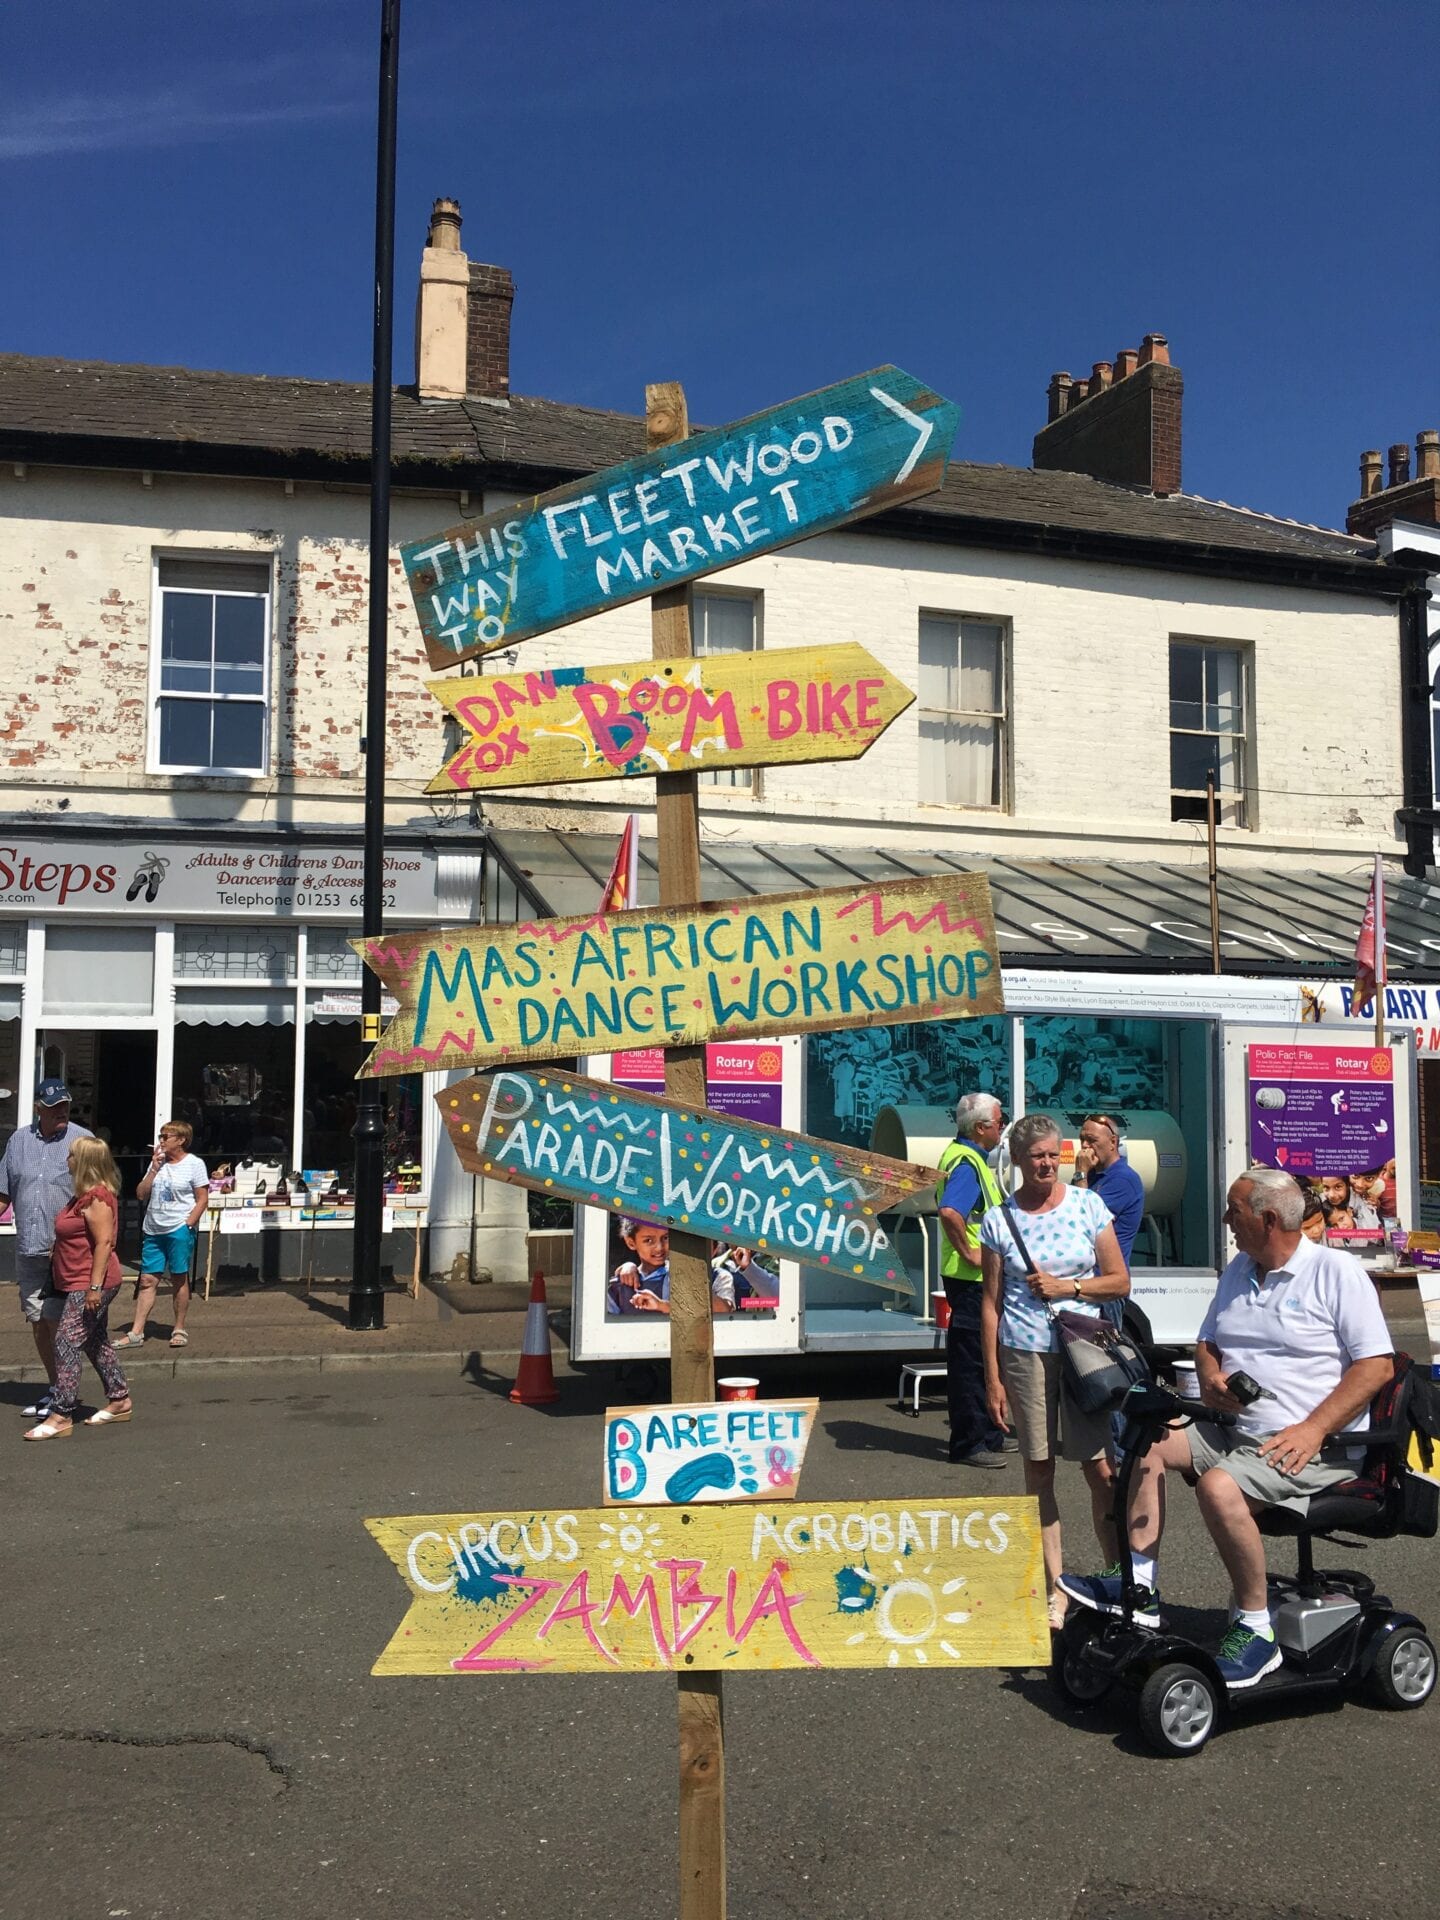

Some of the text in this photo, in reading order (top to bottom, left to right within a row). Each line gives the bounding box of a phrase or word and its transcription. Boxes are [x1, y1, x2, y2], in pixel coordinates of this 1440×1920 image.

[543, 416, 853, 559] FLEETWOOD
[413, 520, 527, 582] THIS
[596, 480, 799, 594] MARKET
[431, 564, 519, 626] WAY
[438, 614, 505, 654] TO
[455, 669, 557, 737] DAN
[572, 678, 884, 766] BOOM BIKE
[447, 725, 530, 789] FOX
[0, 848, 117, 905] Steps
[185, 852, 238, 870] Adults
[242, 854, 254, 870] &
[258, 853, 327, 869] Childrens
[382, 857, 421, 871] Shoes
[216, 871, 299, 887] Dancewear
[302, 874, 314, 889] &
[217, 891, 292, 908] Telephone
[297, 893, 340, 907] 01253
[573, 905, 821, 981] AFRICAN
[518, 948, 993, 1047] DANCE WORKSHOP
[716, 1056, 754, 1070] Rotary
[1255, 1049, 1314, 1061] Polio Fact File
[1335, 1057, 1368, 1070] Rotary
[477, 1073, 890, 1261] PARADE WORKSHOP
[1133, 1286, 1158, 1295] graphics
[1159, 1287, 1168, 1295] by:
[408, 1511, 1010, 1593] CIRCUS ACROBATICS
[451, 1558, 821, 1670] ZAMBIA
